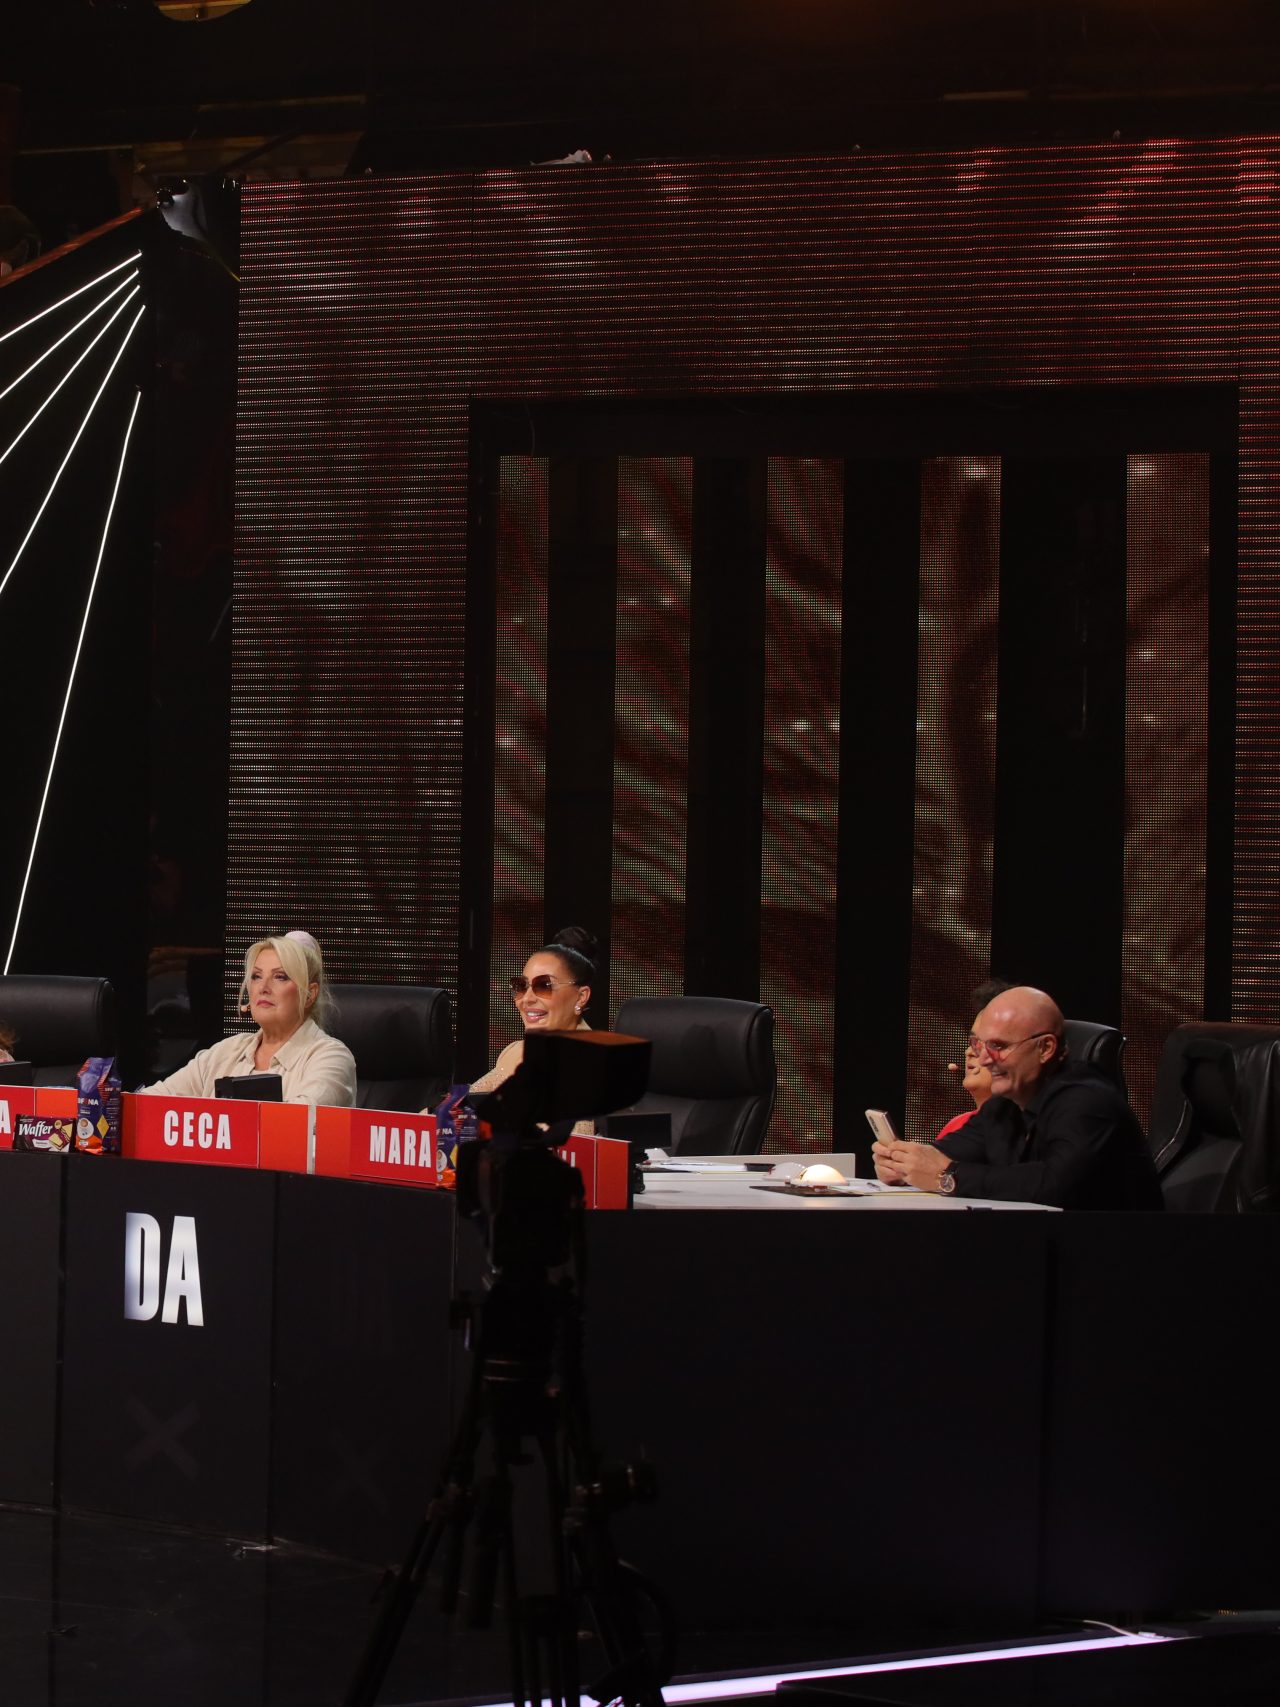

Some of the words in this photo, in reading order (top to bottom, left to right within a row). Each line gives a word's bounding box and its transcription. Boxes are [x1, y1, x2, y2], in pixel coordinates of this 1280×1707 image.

[18, 1120, 53, 1137] Waffer
[163, 1109, 232, 1150] CECA
[369, 1125, 432, 1168] MARA
[124, 1212, 204, 1327] DA
